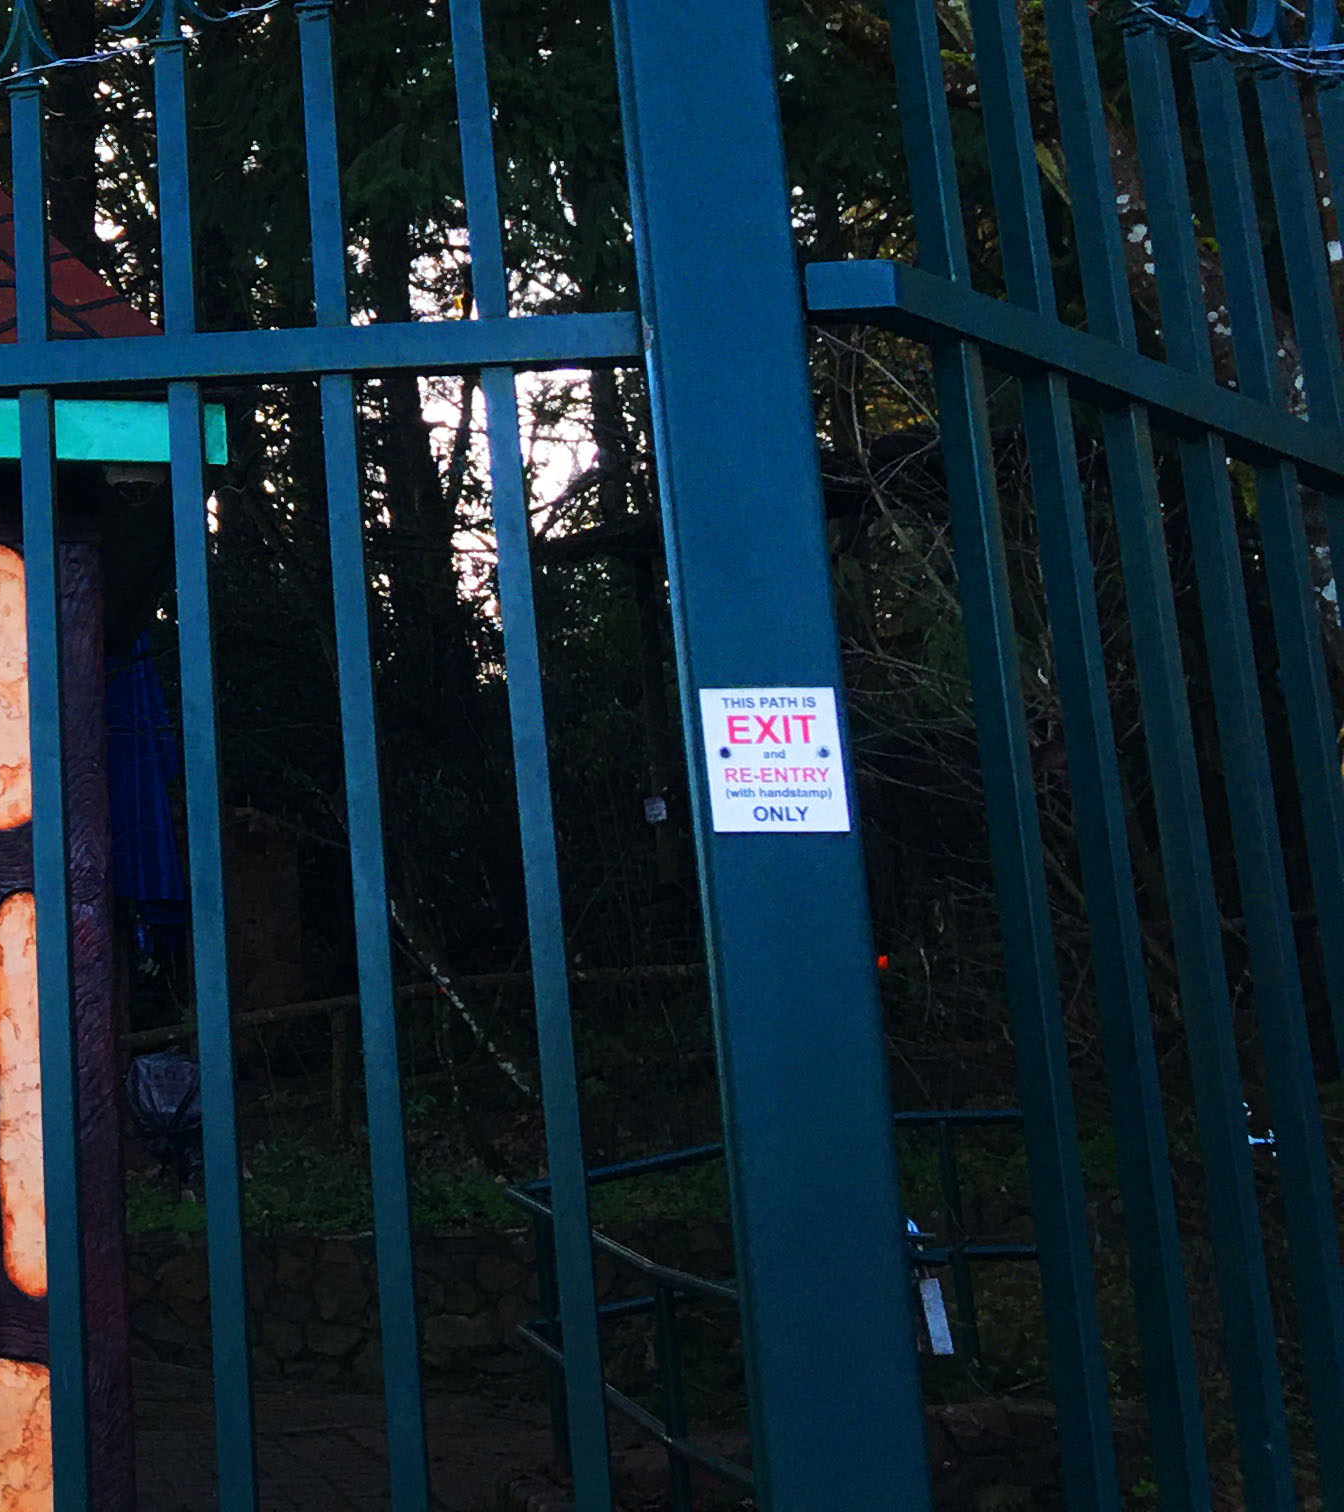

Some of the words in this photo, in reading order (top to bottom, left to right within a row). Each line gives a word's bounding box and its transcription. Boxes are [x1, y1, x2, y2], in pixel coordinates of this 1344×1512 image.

[721, 697, 755, 709] THIS
[759, 697, 798, 709] PATH
[802, 697, 816, 708] IS
[726, 715, 816, 744] EXIT
[763, 749, 786, 759] and
[724, 767, 830, 783] RE-ENTRY
[725, 788, 756, 799] (with
[759, 788, 832, 800] handstamp)
[753, 806, 809, 822] ONLY
